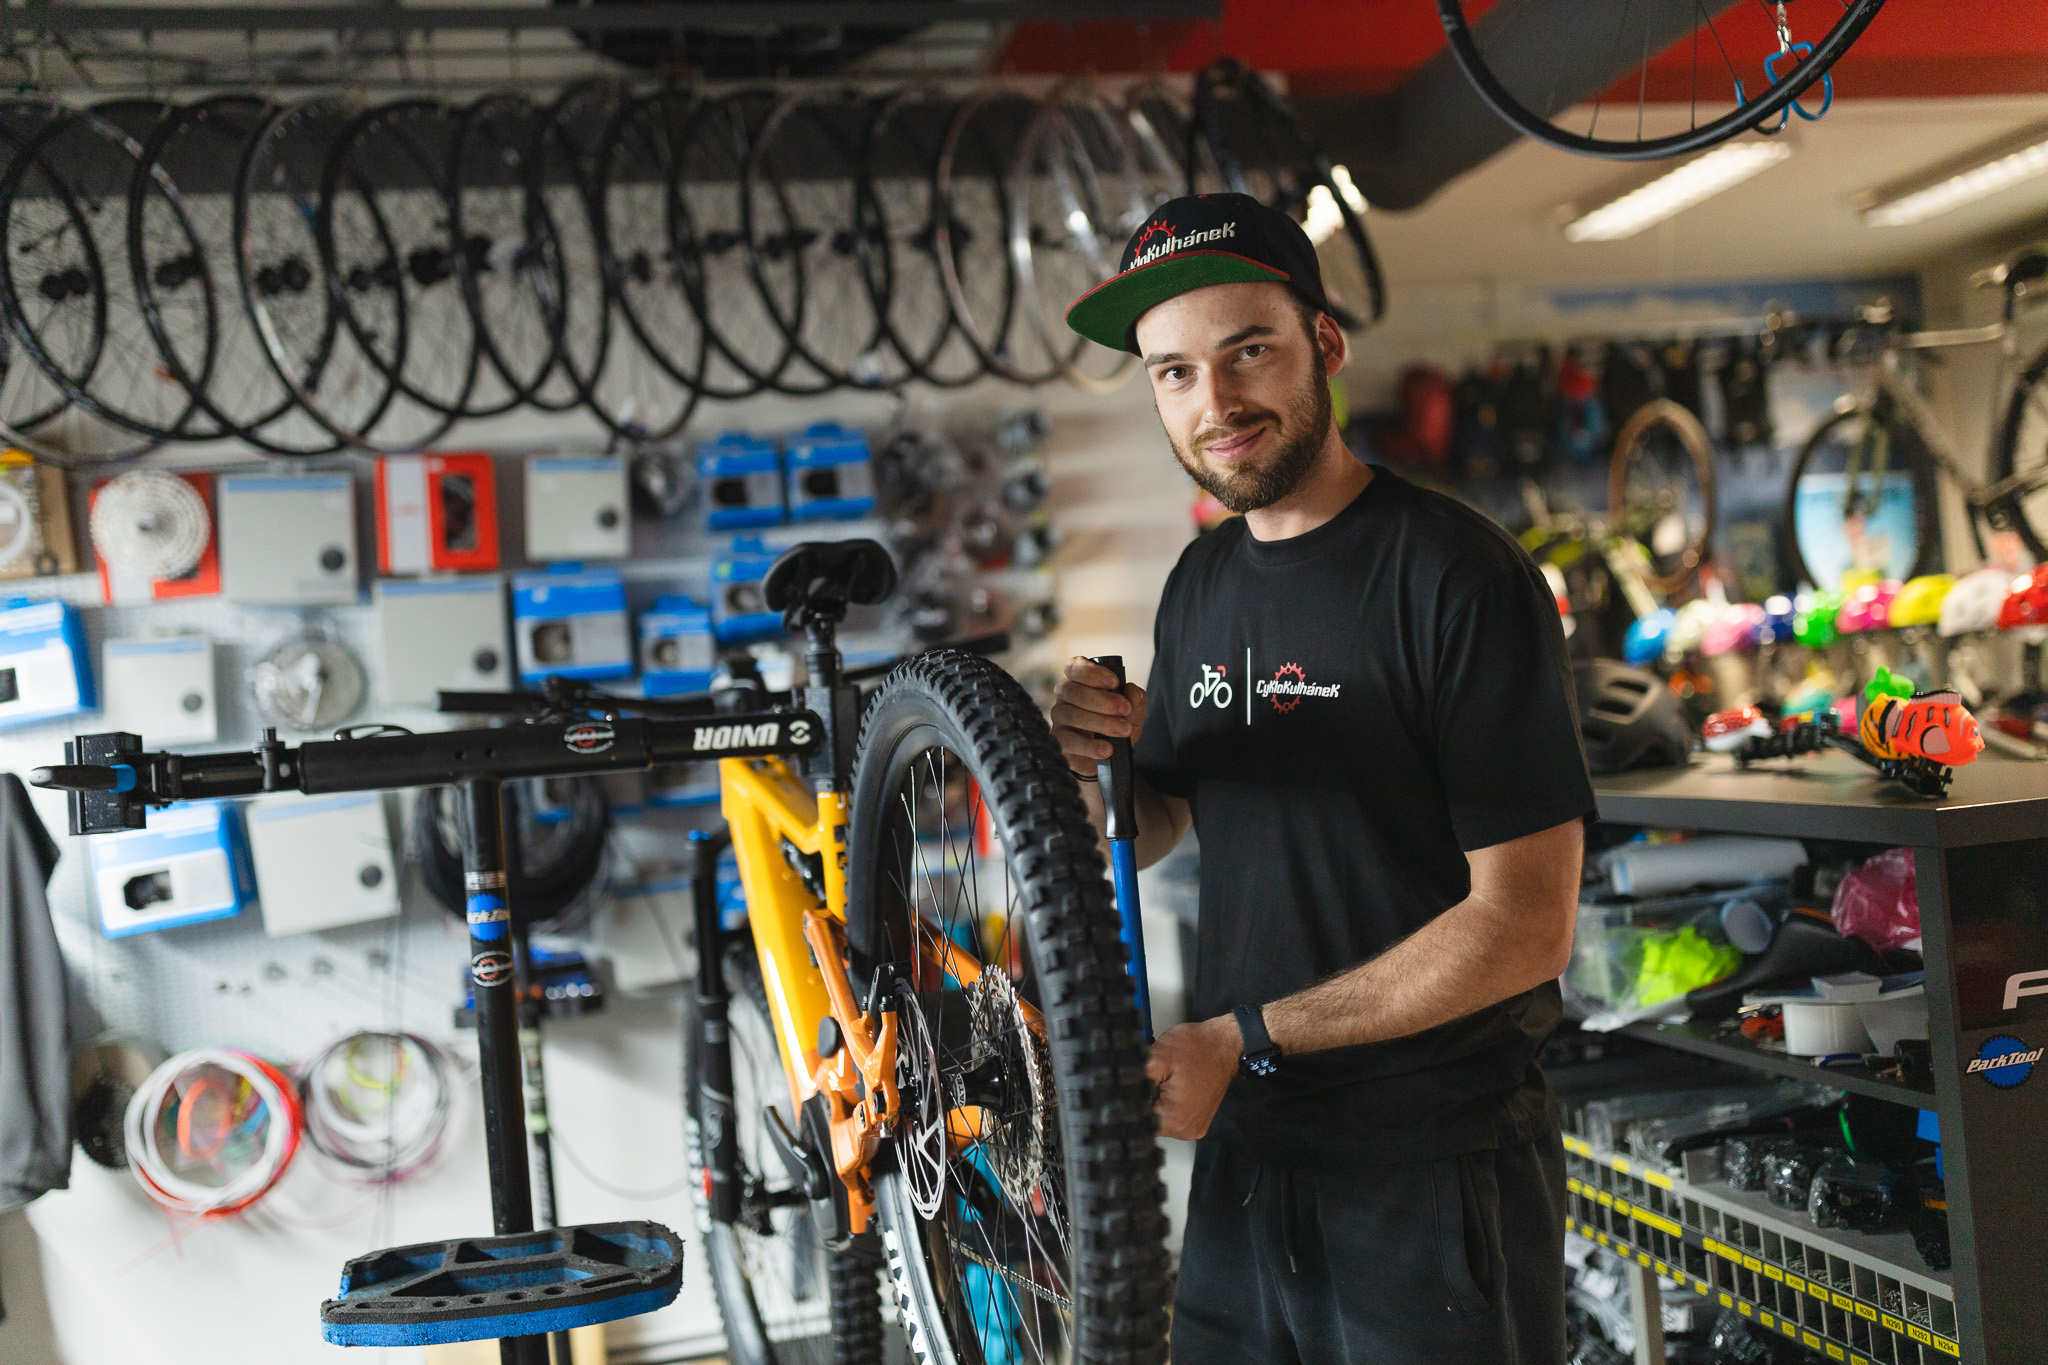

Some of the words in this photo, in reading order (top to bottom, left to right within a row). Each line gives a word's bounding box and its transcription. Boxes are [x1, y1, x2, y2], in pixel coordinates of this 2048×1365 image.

[693, 722, 780, 751] UNIOR
[884, 1229, 931, 1365] AXXIS
[1912, 1328, 1928, 1342] N292
[1938, 1338, 1954, 1352] N294
